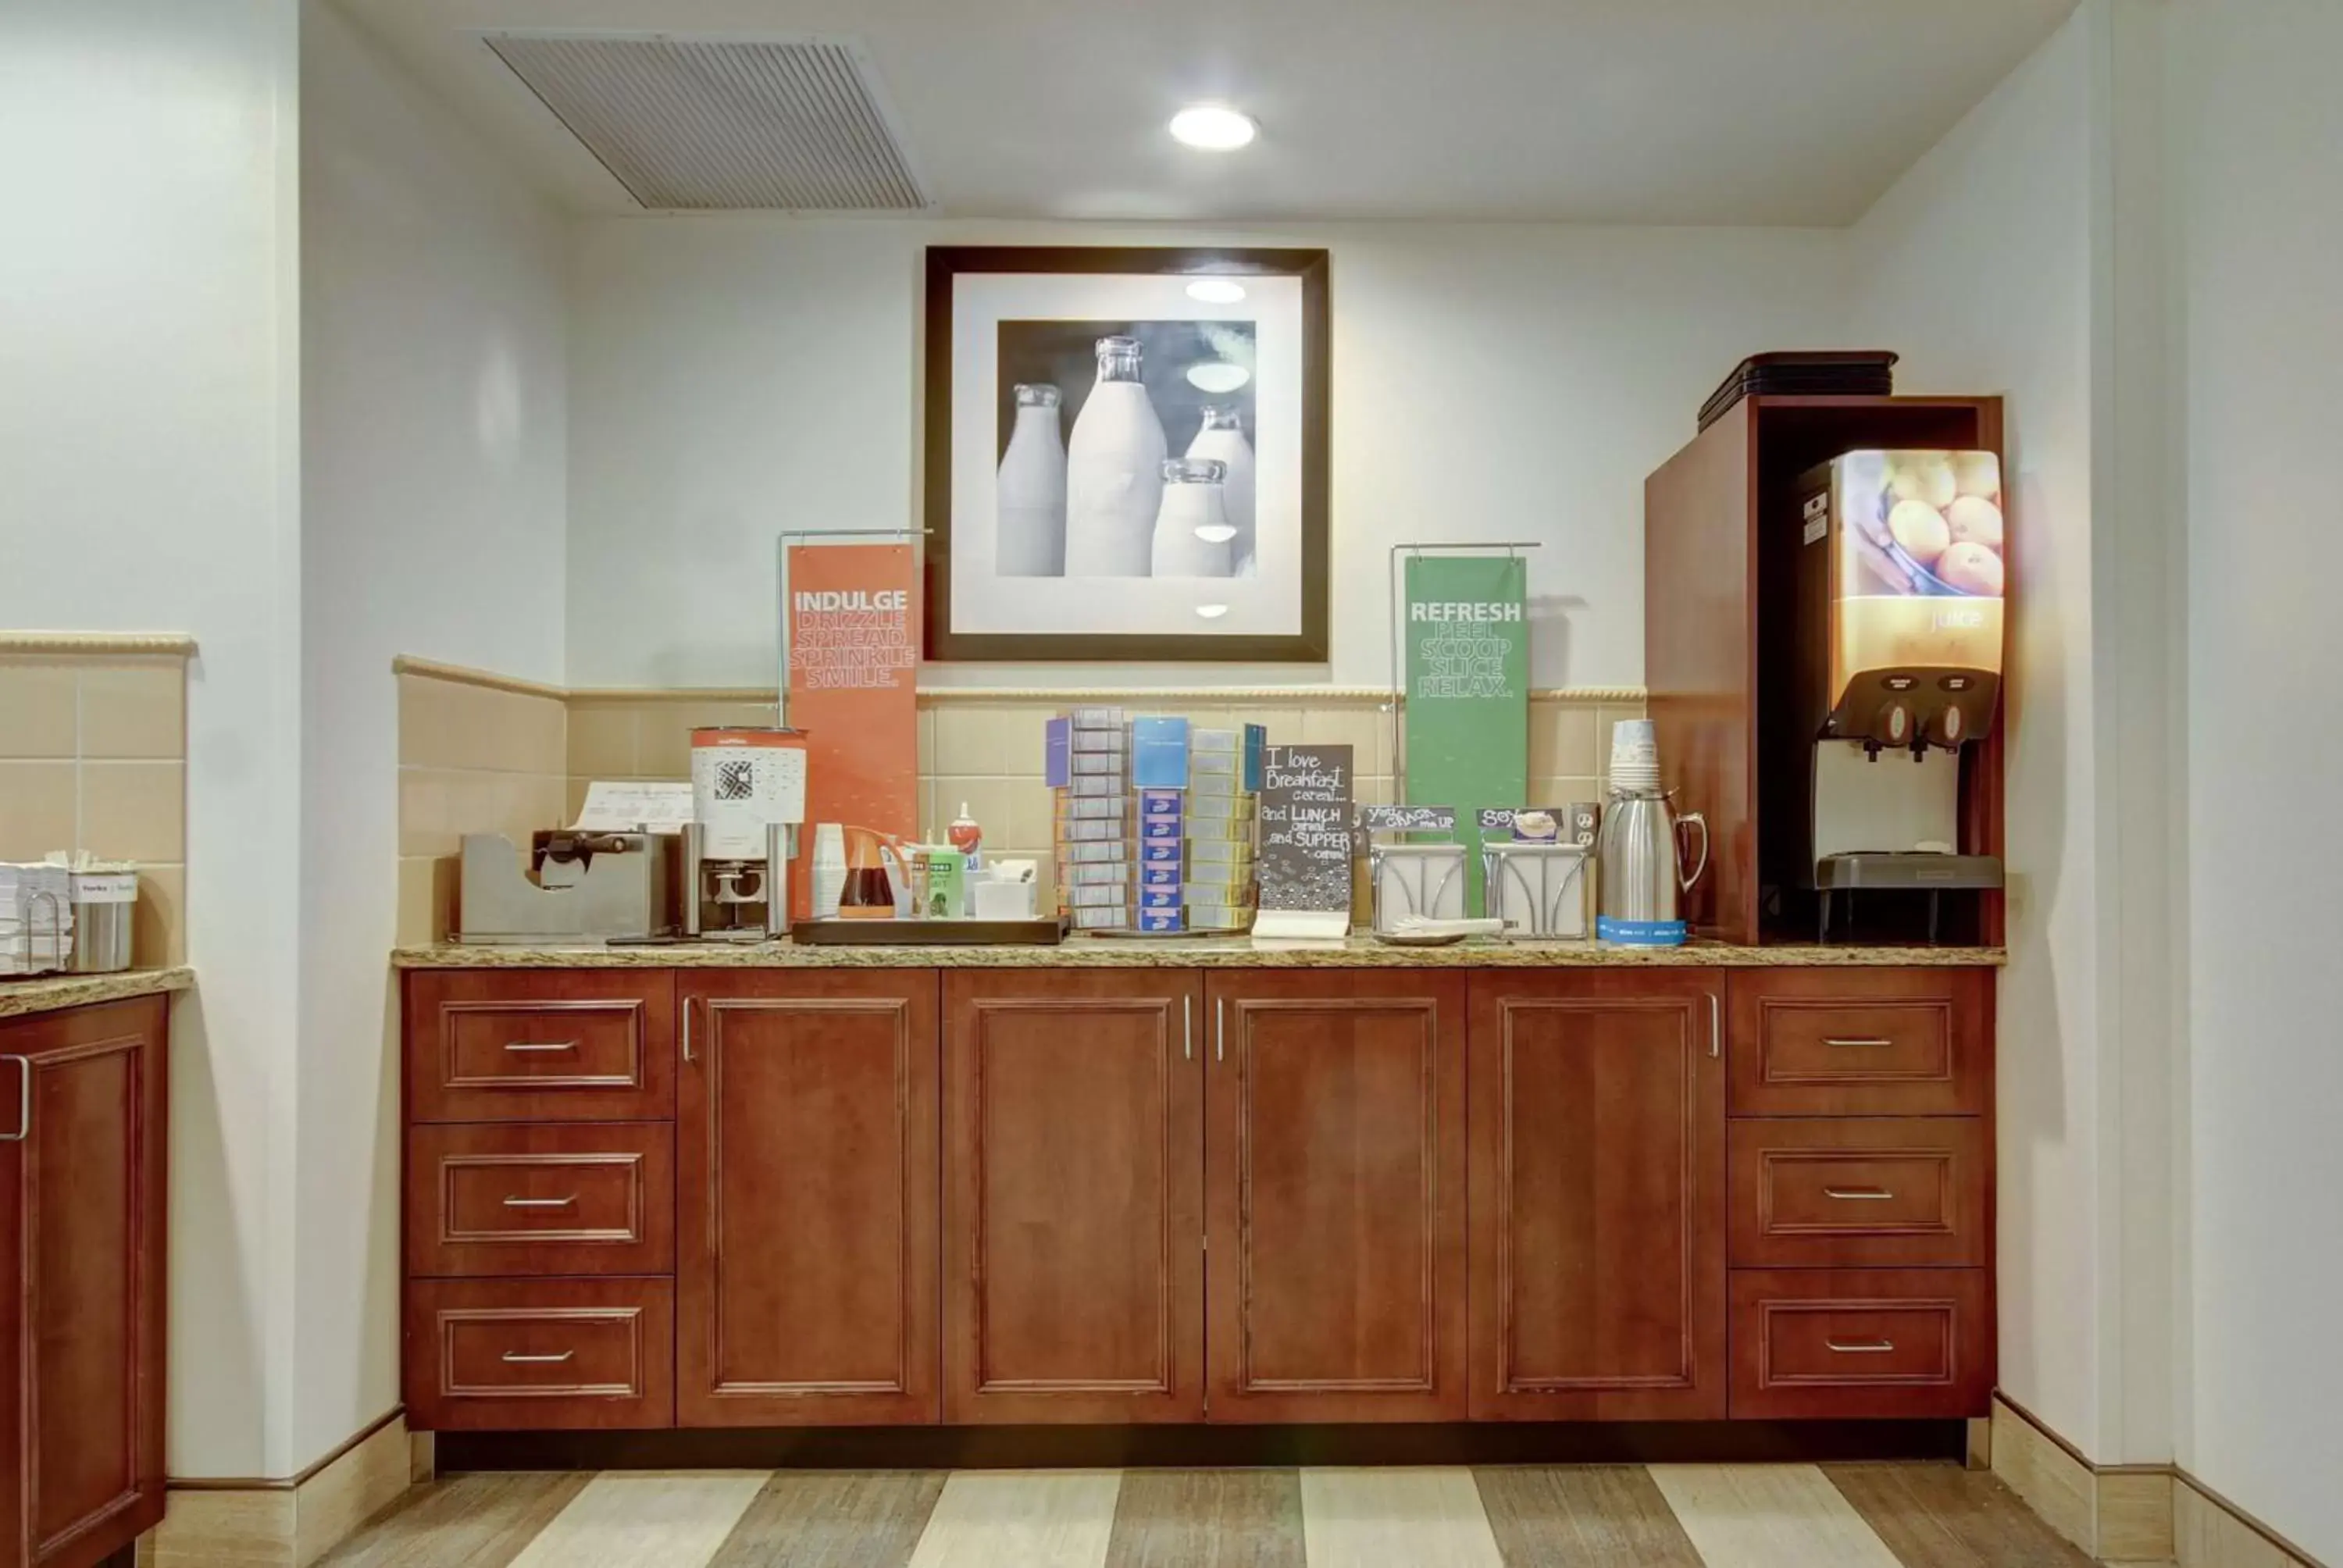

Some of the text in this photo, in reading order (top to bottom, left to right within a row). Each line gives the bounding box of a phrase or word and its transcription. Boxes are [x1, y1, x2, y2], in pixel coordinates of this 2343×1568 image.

[794, 591, 908, 611] INDULGE
[1410, 601, 1521, 622] REFRESH
[797, 611, 904, 629] DRIZZLE
[1931, 611, 1983, 633] juice
[796, 628, 906, 648] SPREAD
[1420, 638, 1513, 659] SCOOP
[789, 647, 915, 669] SPRINKLE
[1428, 657, 1503, 678] SLICE
[1264, 747, 1321, 769] I love
[1266, 766, 1344, 789] Breakfast
[1262, 804, 1341, 822] and LUNCH
[1269, 830, 1350, 852] and SUPPER
